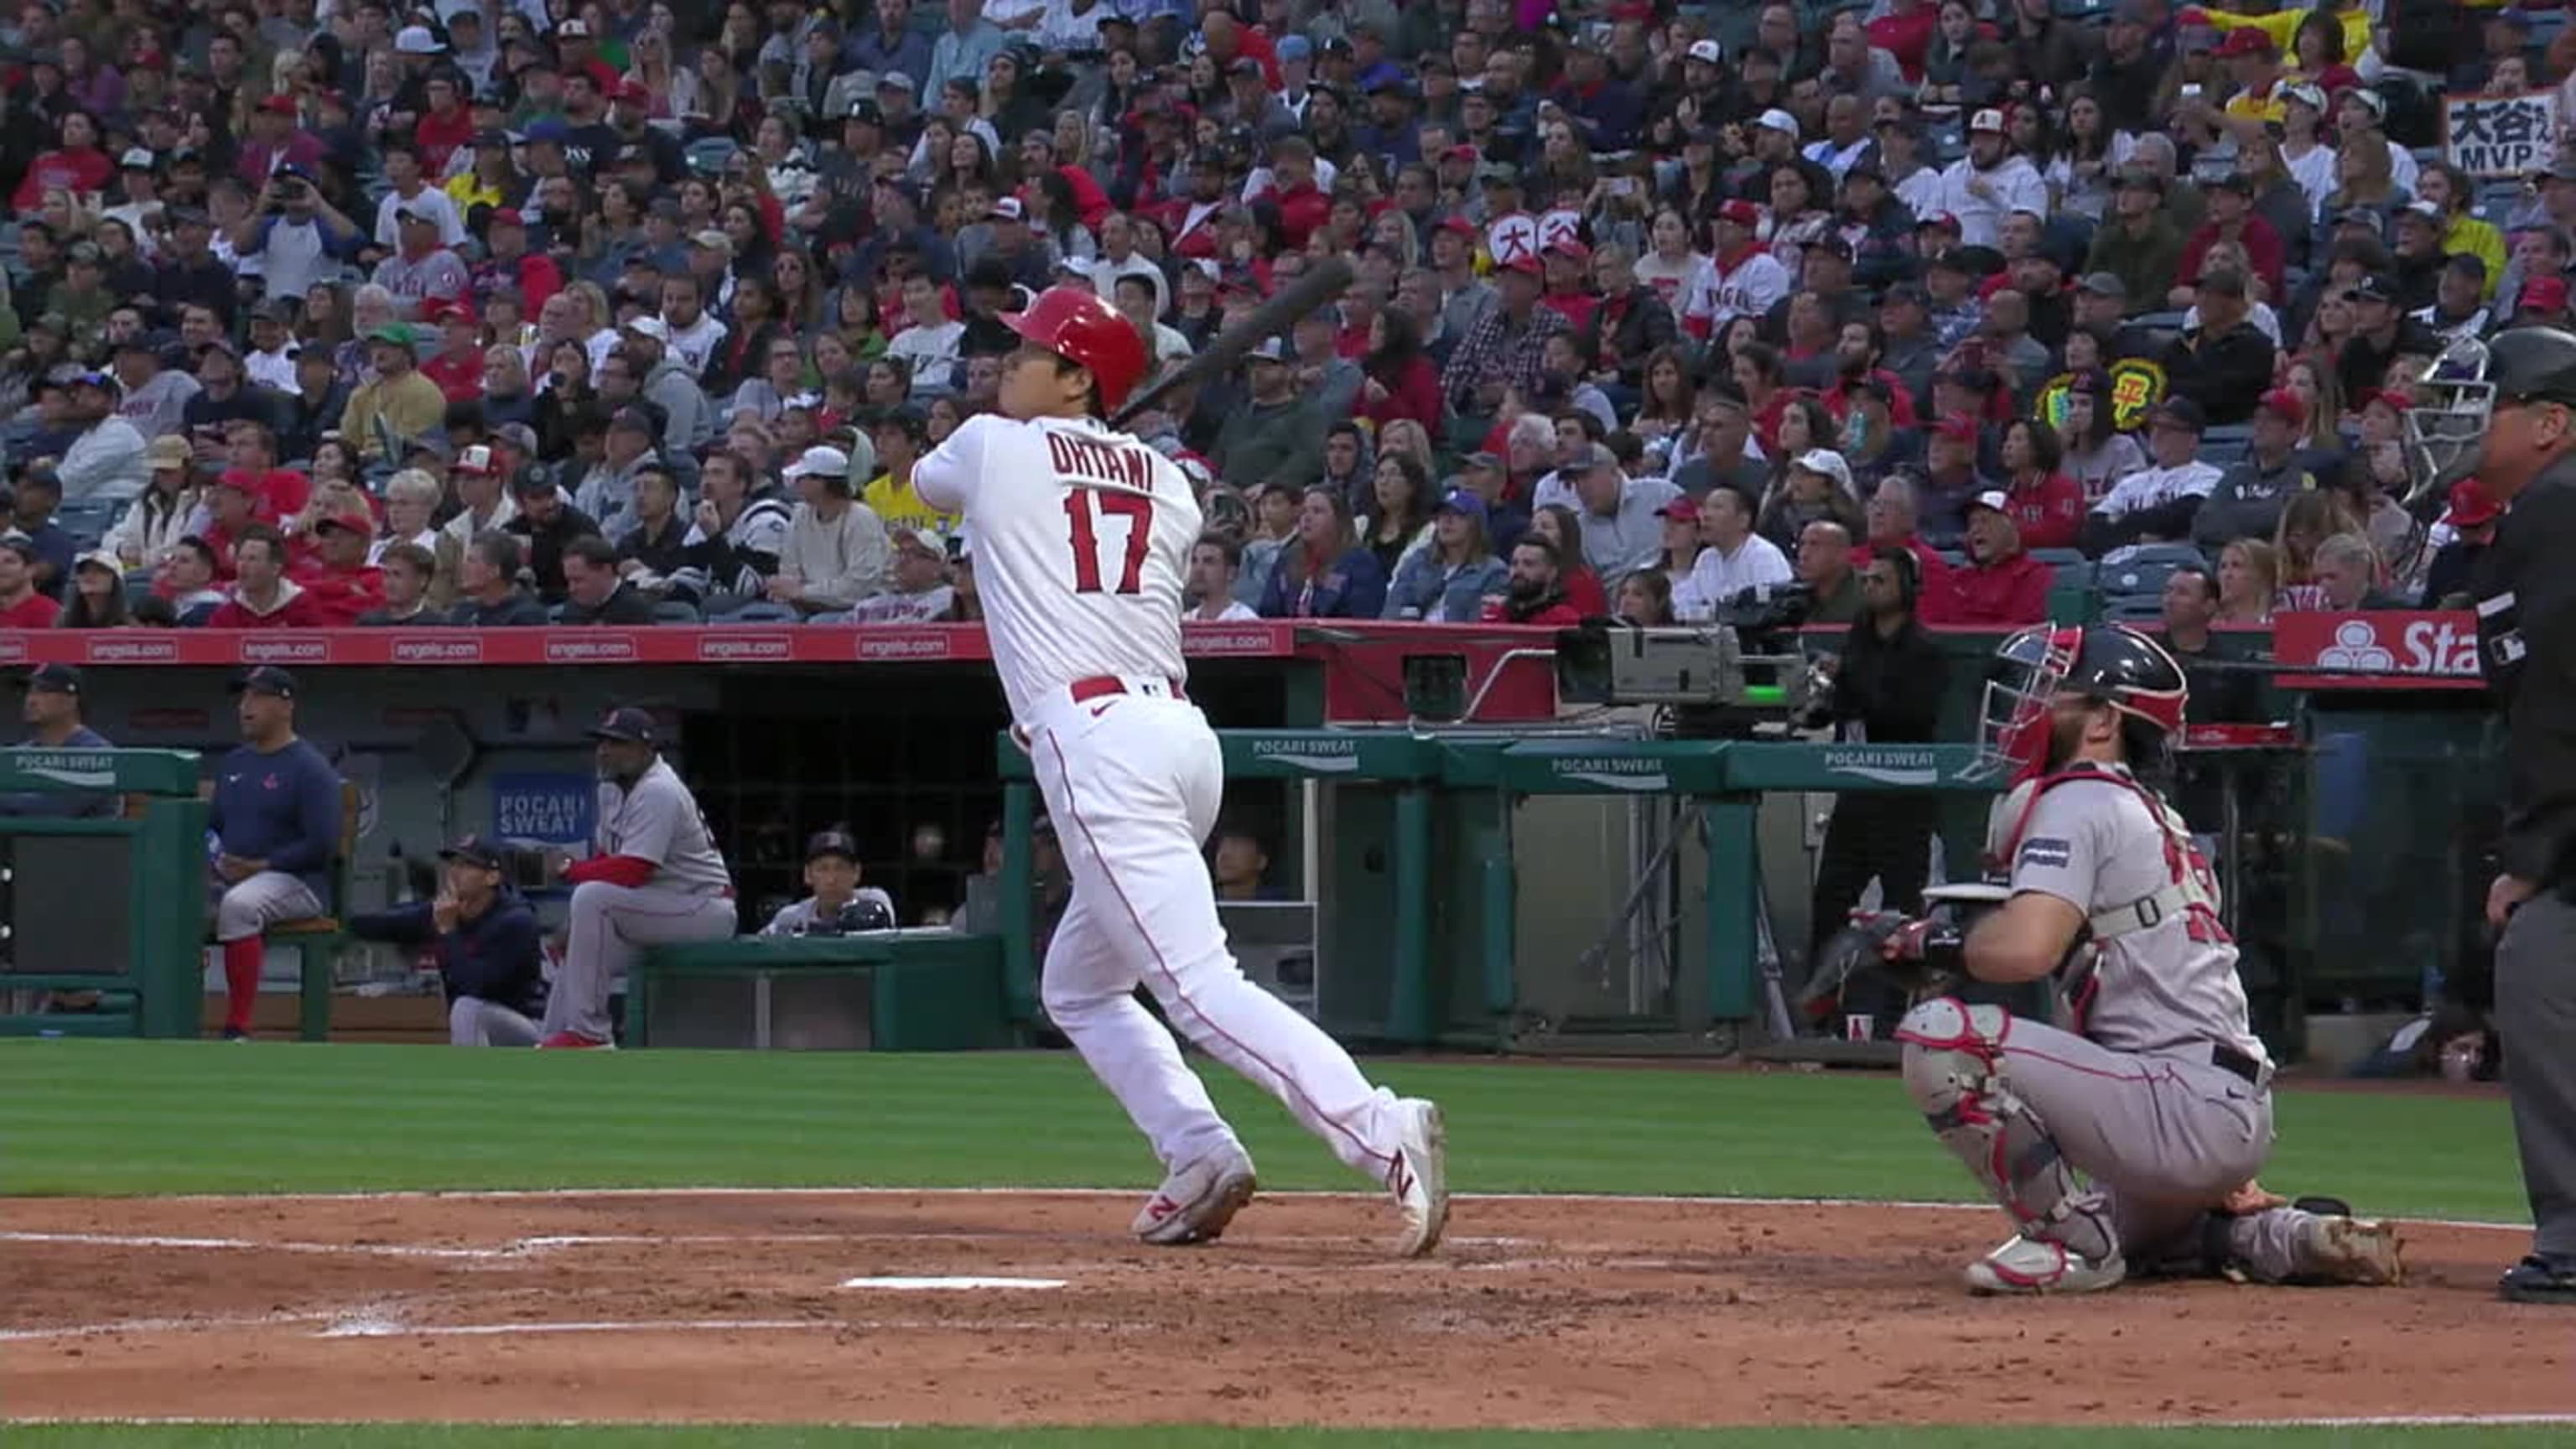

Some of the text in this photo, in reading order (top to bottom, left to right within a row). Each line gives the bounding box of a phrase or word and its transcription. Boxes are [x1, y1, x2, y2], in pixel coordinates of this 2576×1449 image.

[2450, 101, 2532, 144] 大谷
[2460, 145, 2532, 170] MVP
[1046, 431, 1152, 492] OHTANI
[1063, 487, 1153, 594] 17
[93, 643, 174, 659] angels.com
[245, 643, 325, 660] angels.com
[397, 642, 477, 658] angels.com
[549, 643, 630, 659] angels.com
[703, 641, 787, 657] angels.com
[862, 640, 945, 656] angels.com
[2401, 621, 2480, 674] Sta
[1254, 740, 1355, 753] POCARI SWEAT
[16, 756, 66, 769] POCARI
[1551, 757, 1663, 771] POCARI SWEAT
[1825, 751, 1933, 766] POCARI SWEAT
[501, 795, 585, 816] POCARI
[501, 815, 576, 834] SWEAT
